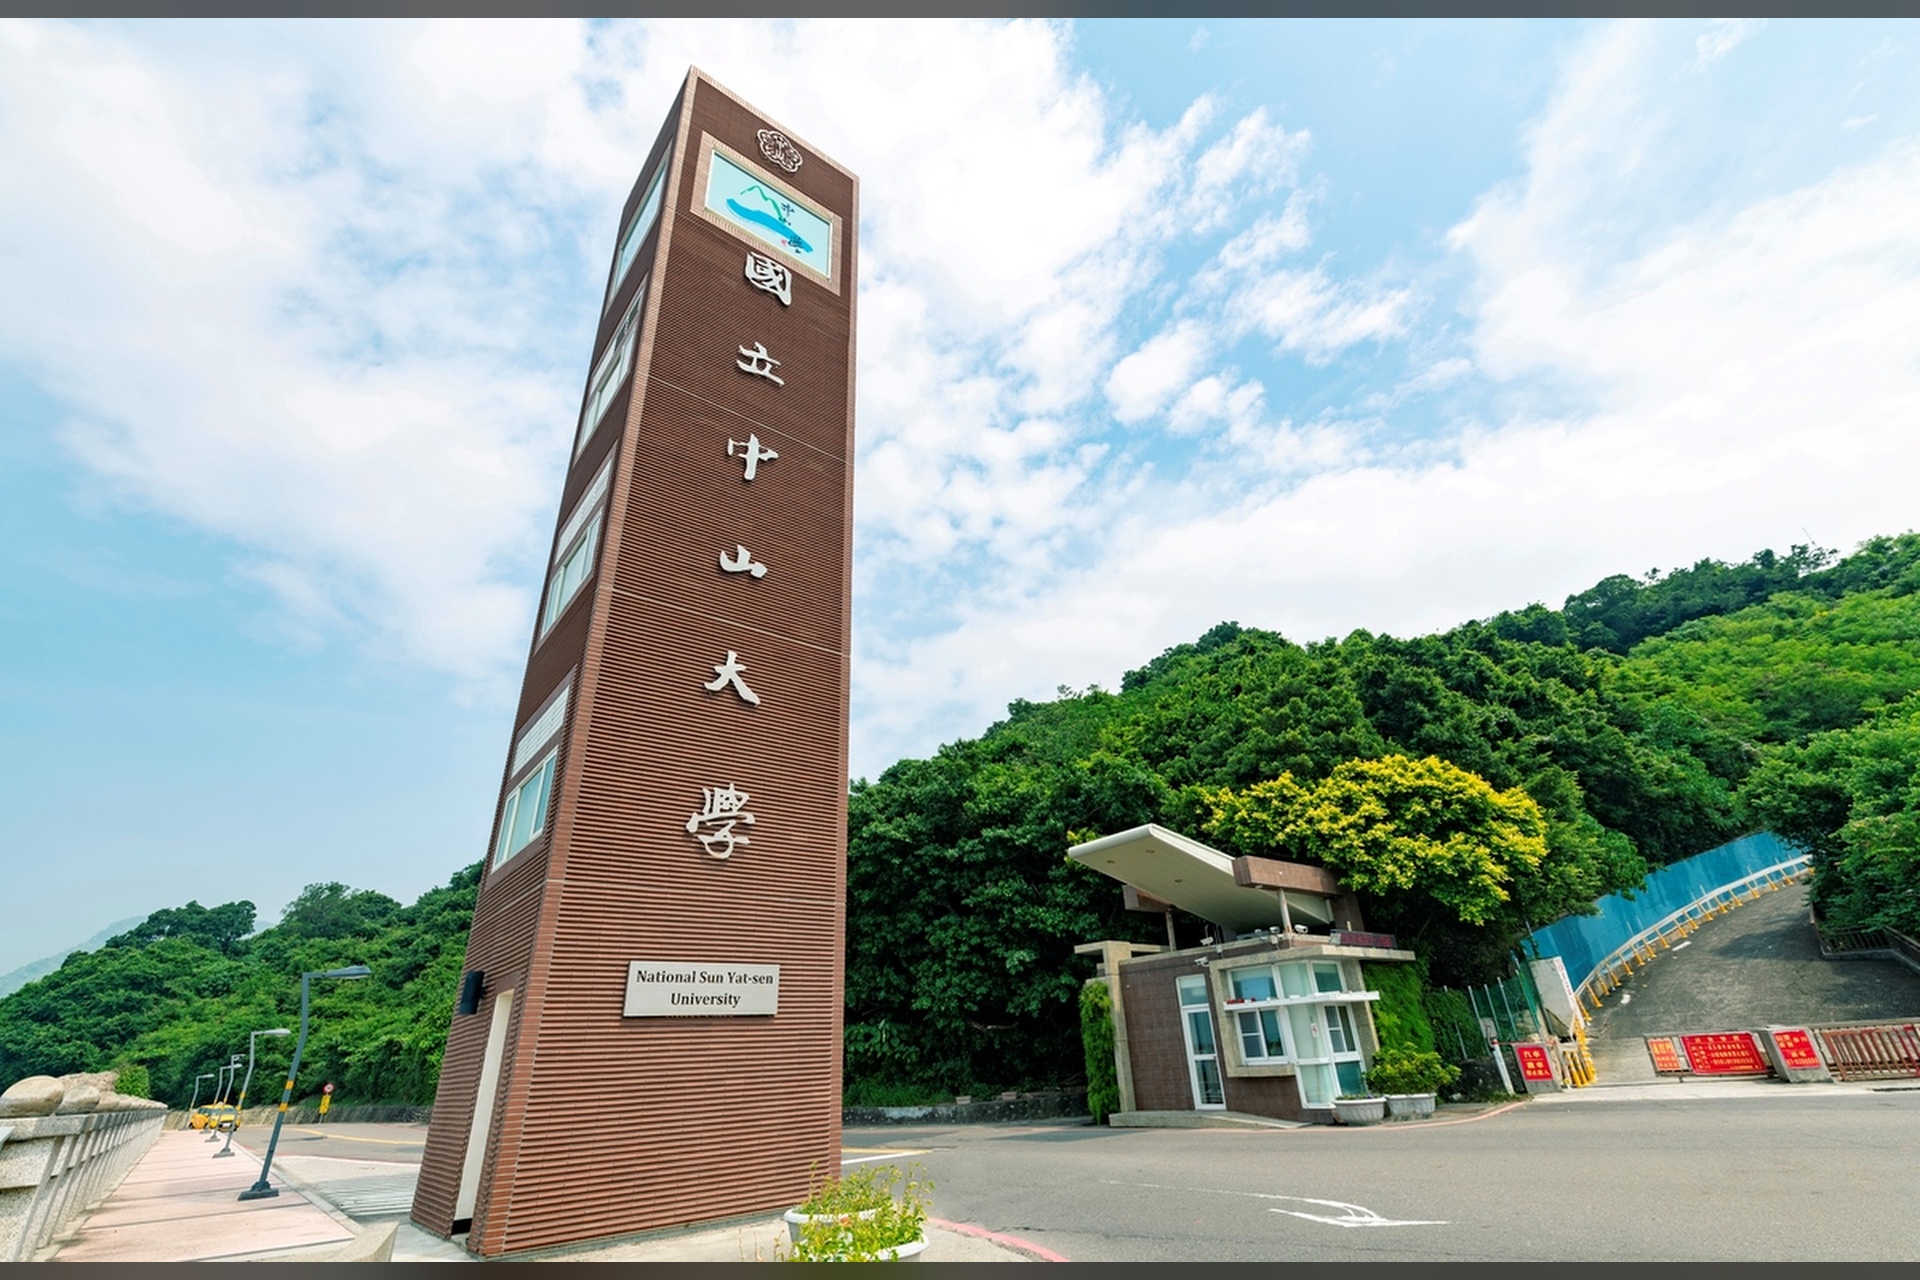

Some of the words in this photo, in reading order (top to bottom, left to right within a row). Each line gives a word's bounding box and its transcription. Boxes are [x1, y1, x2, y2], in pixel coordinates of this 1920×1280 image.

[685, 251, 793, 859] 國立中山大學
[636, 970, 696, 984] National
[698, 971, 724, 984] Sun
[727, 971, 774, 985] Yat-sen
[670, 992, 741, 1008] University
